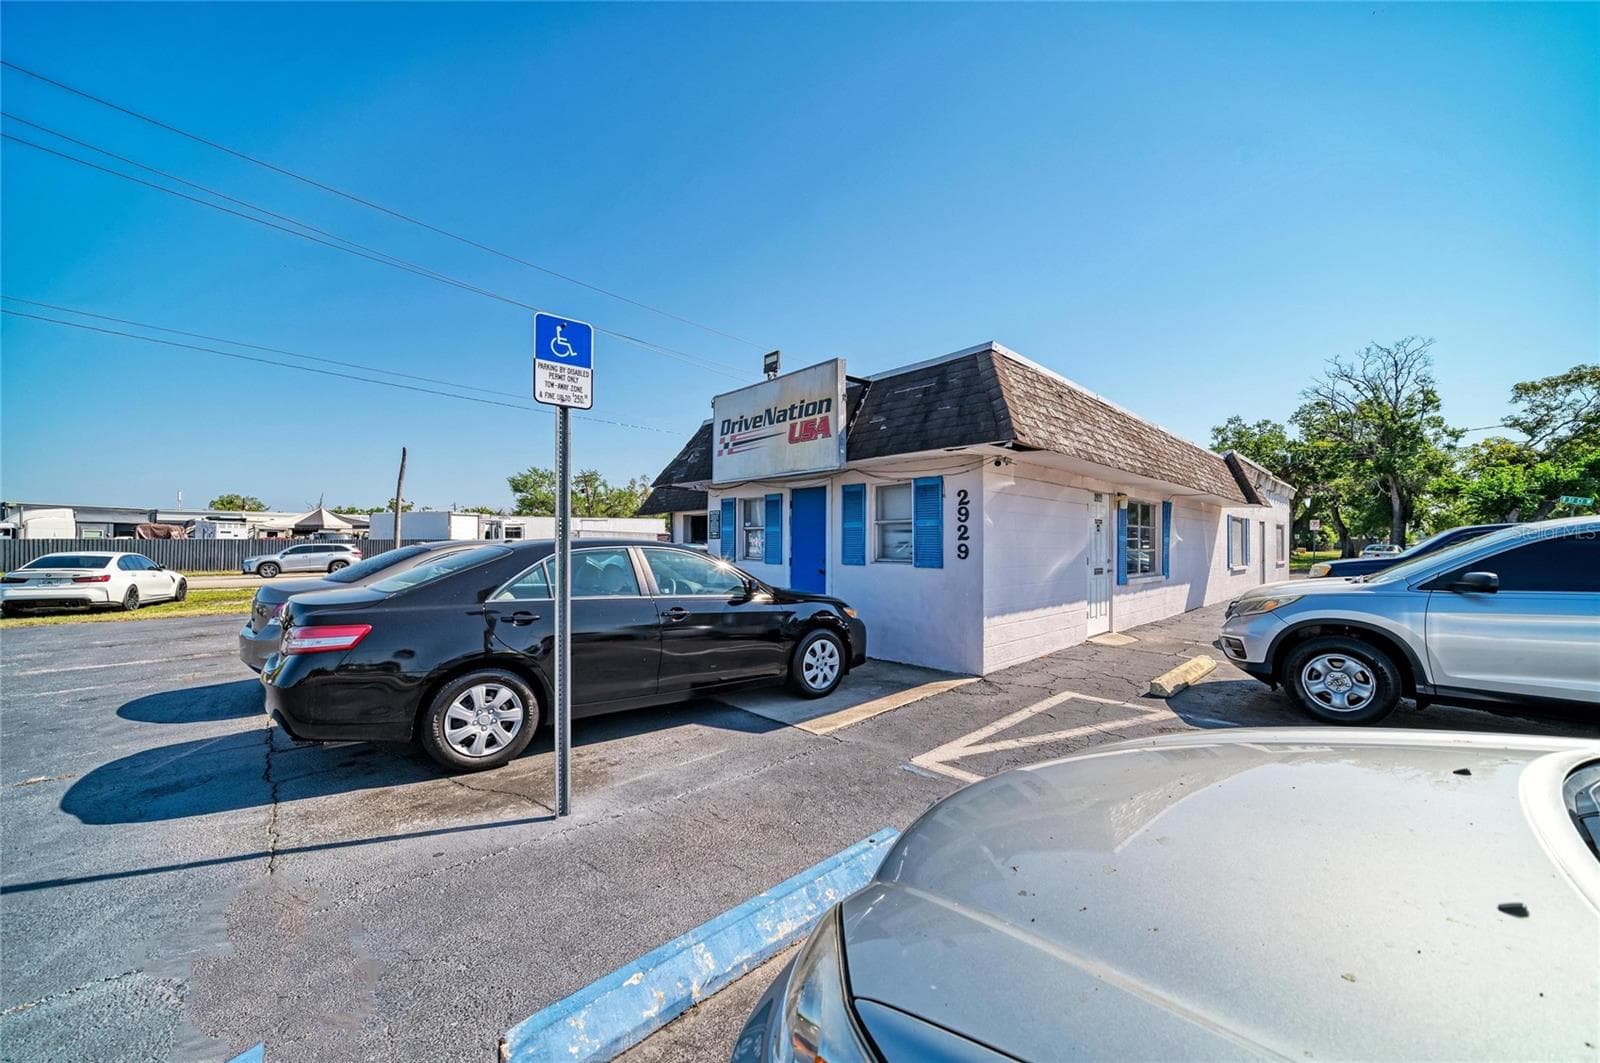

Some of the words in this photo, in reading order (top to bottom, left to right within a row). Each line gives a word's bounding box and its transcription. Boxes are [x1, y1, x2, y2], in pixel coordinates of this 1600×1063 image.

[538, 362, 558, 372] PARKING
[567, 368, 589, 378] DISABLED
[549, 372, 565, 380] PERMIT
[567, 375, 578, 383] ONLY
[570, 384, 583, 394] ZONE
[720, 398, 832, 437] DriveNation
[788, 415, 832, 445] USA
[957, 489, 970, 560] 2929
